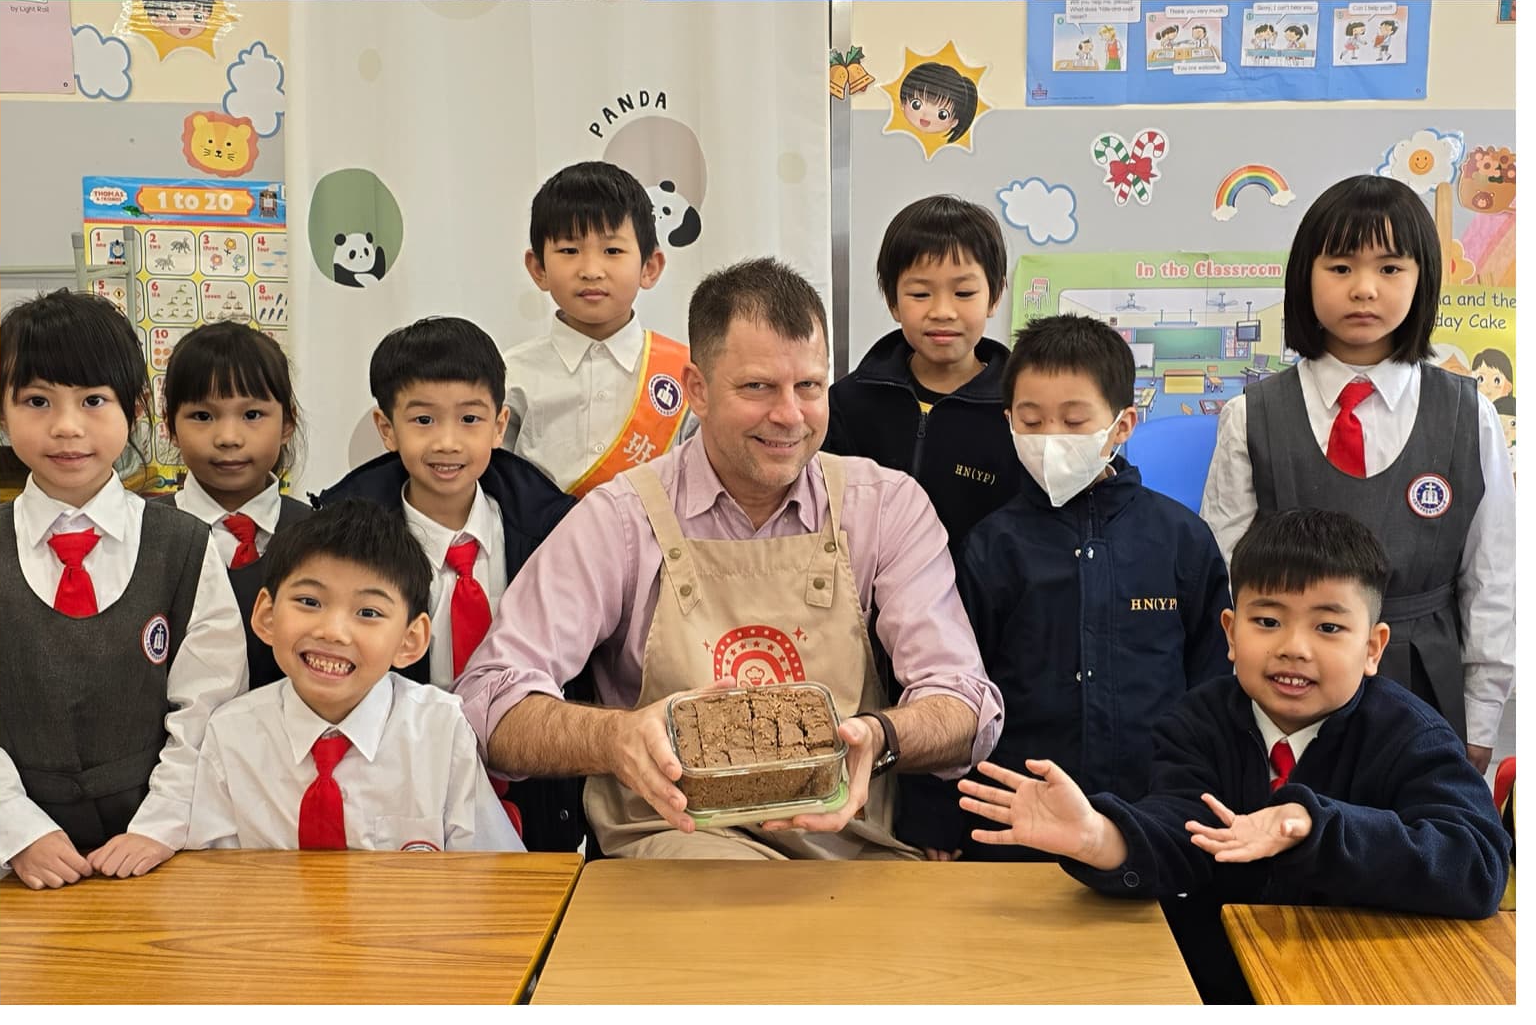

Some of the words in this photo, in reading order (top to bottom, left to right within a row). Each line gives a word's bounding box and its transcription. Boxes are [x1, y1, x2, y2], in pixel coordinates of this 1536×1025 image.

[20, 6, 35, 14] Light
[589, 90, 667, 138] PANDA
[157, 191, 167, 209] 1
[173, 192, 199, 210] to
[204, 192, 234, 211] 20
[95, 232, 101, 242] 1
[150, 233, 157, 243] 2
[203, 234, 210, 244] 3
[257, 236, 265, 246] 4
[1136, 262, 1154, 277] In
[1161, 262, 1188, 277] the
[1194, 261, 1282, 277] Classroom
[98, 280, 105, 290] 5
[151, 282, 159, 291] 6
[204, 283, 211, 293] 7
[259, 284, 266, 294] 8
[1457, 291, 1486, 307] and
[1492, 292, 1516, 309] the
[1469, 313, 1507, 329] Cake
[154, 329, 169, 339] 10
[623, 431, 657, 464] 班
[955, 464, 996, 486] HN(YP)
